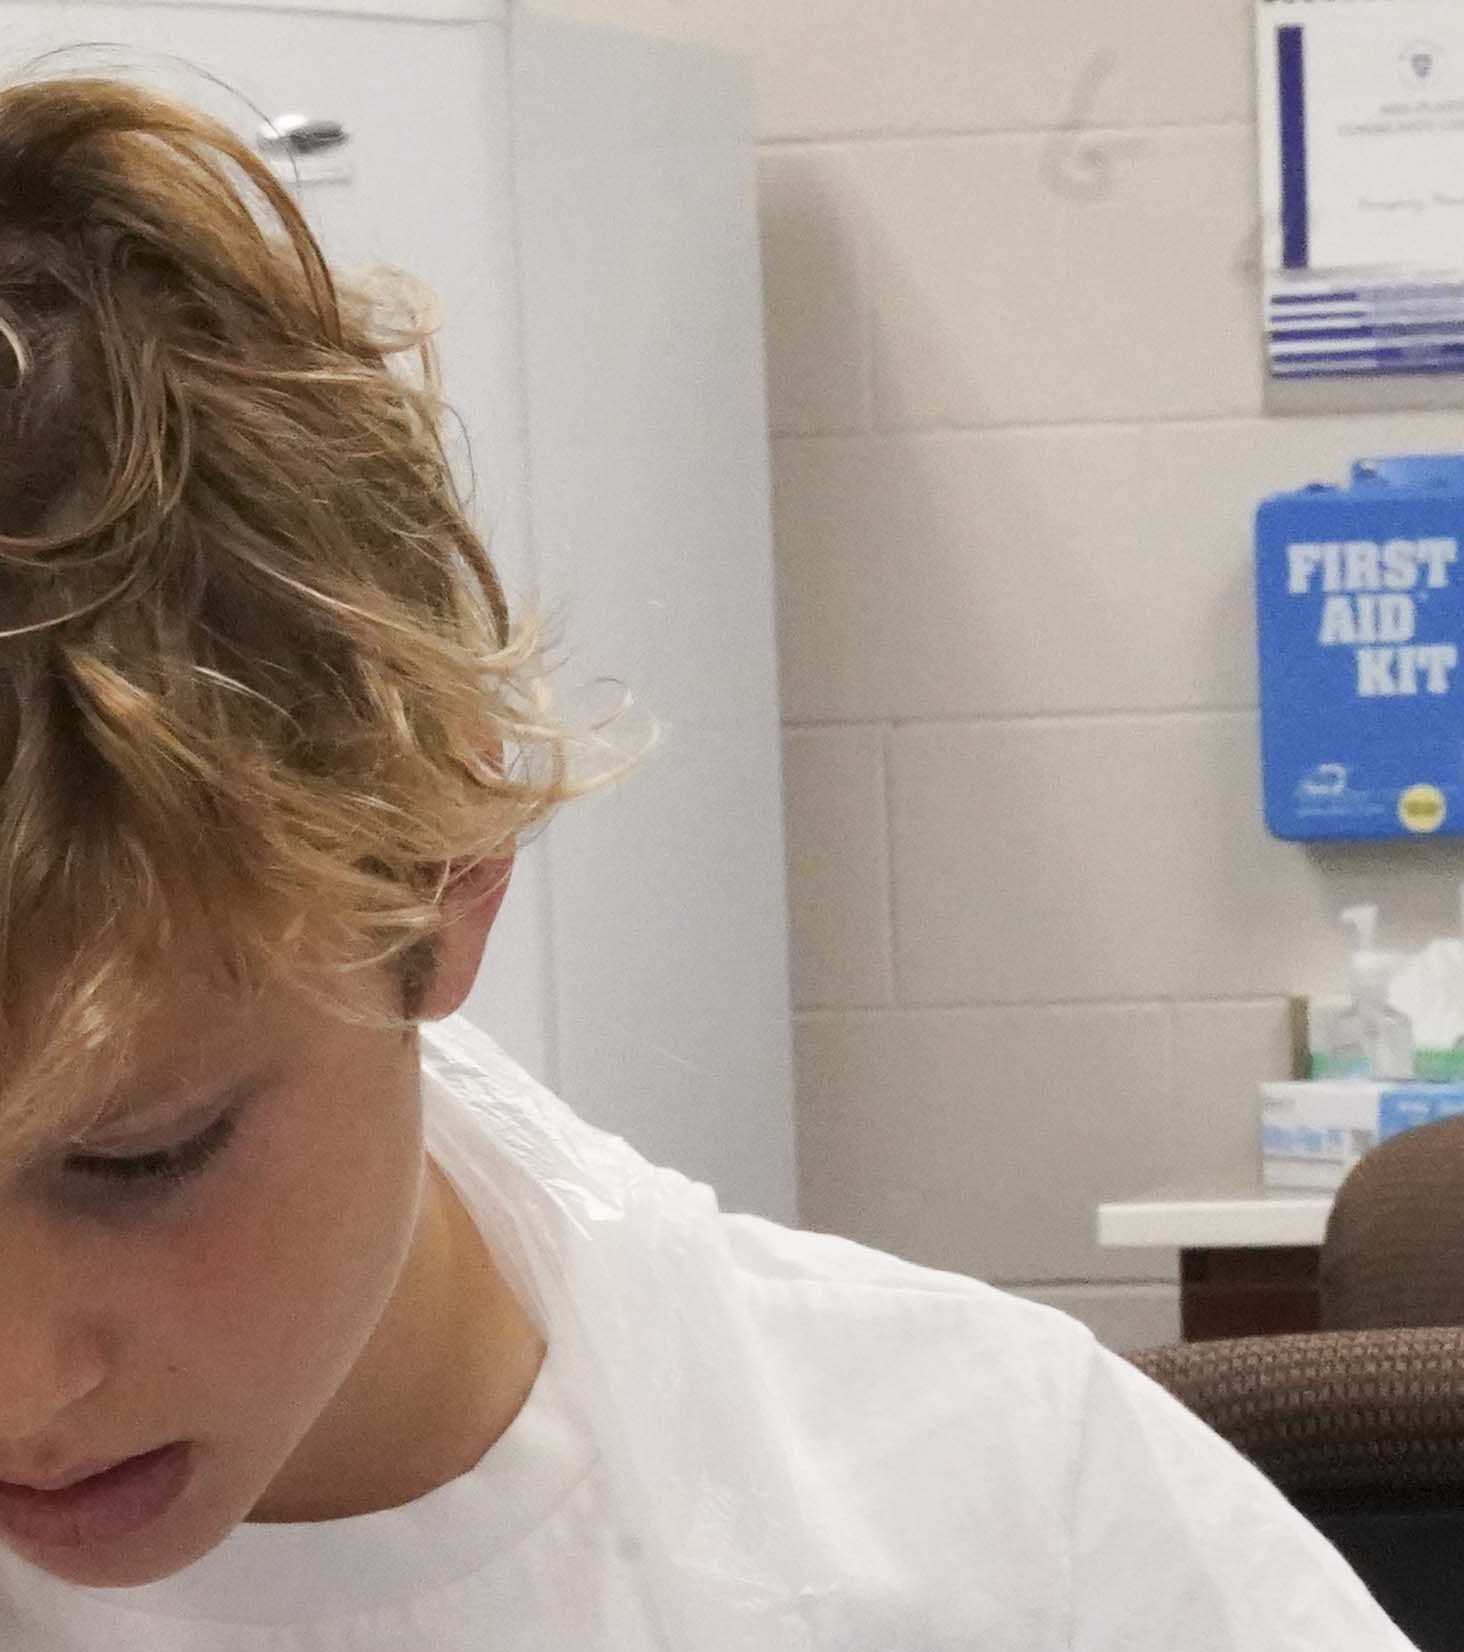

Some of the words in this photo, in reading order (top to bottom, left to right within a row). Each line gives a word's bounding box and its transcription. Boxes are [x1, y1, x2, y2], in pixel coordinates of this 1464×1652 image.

[1287, 536, 1459, 595] FIRST
[1318, 592, 1417, 647] AID
[1356, 642, 1459, 698] KIT
